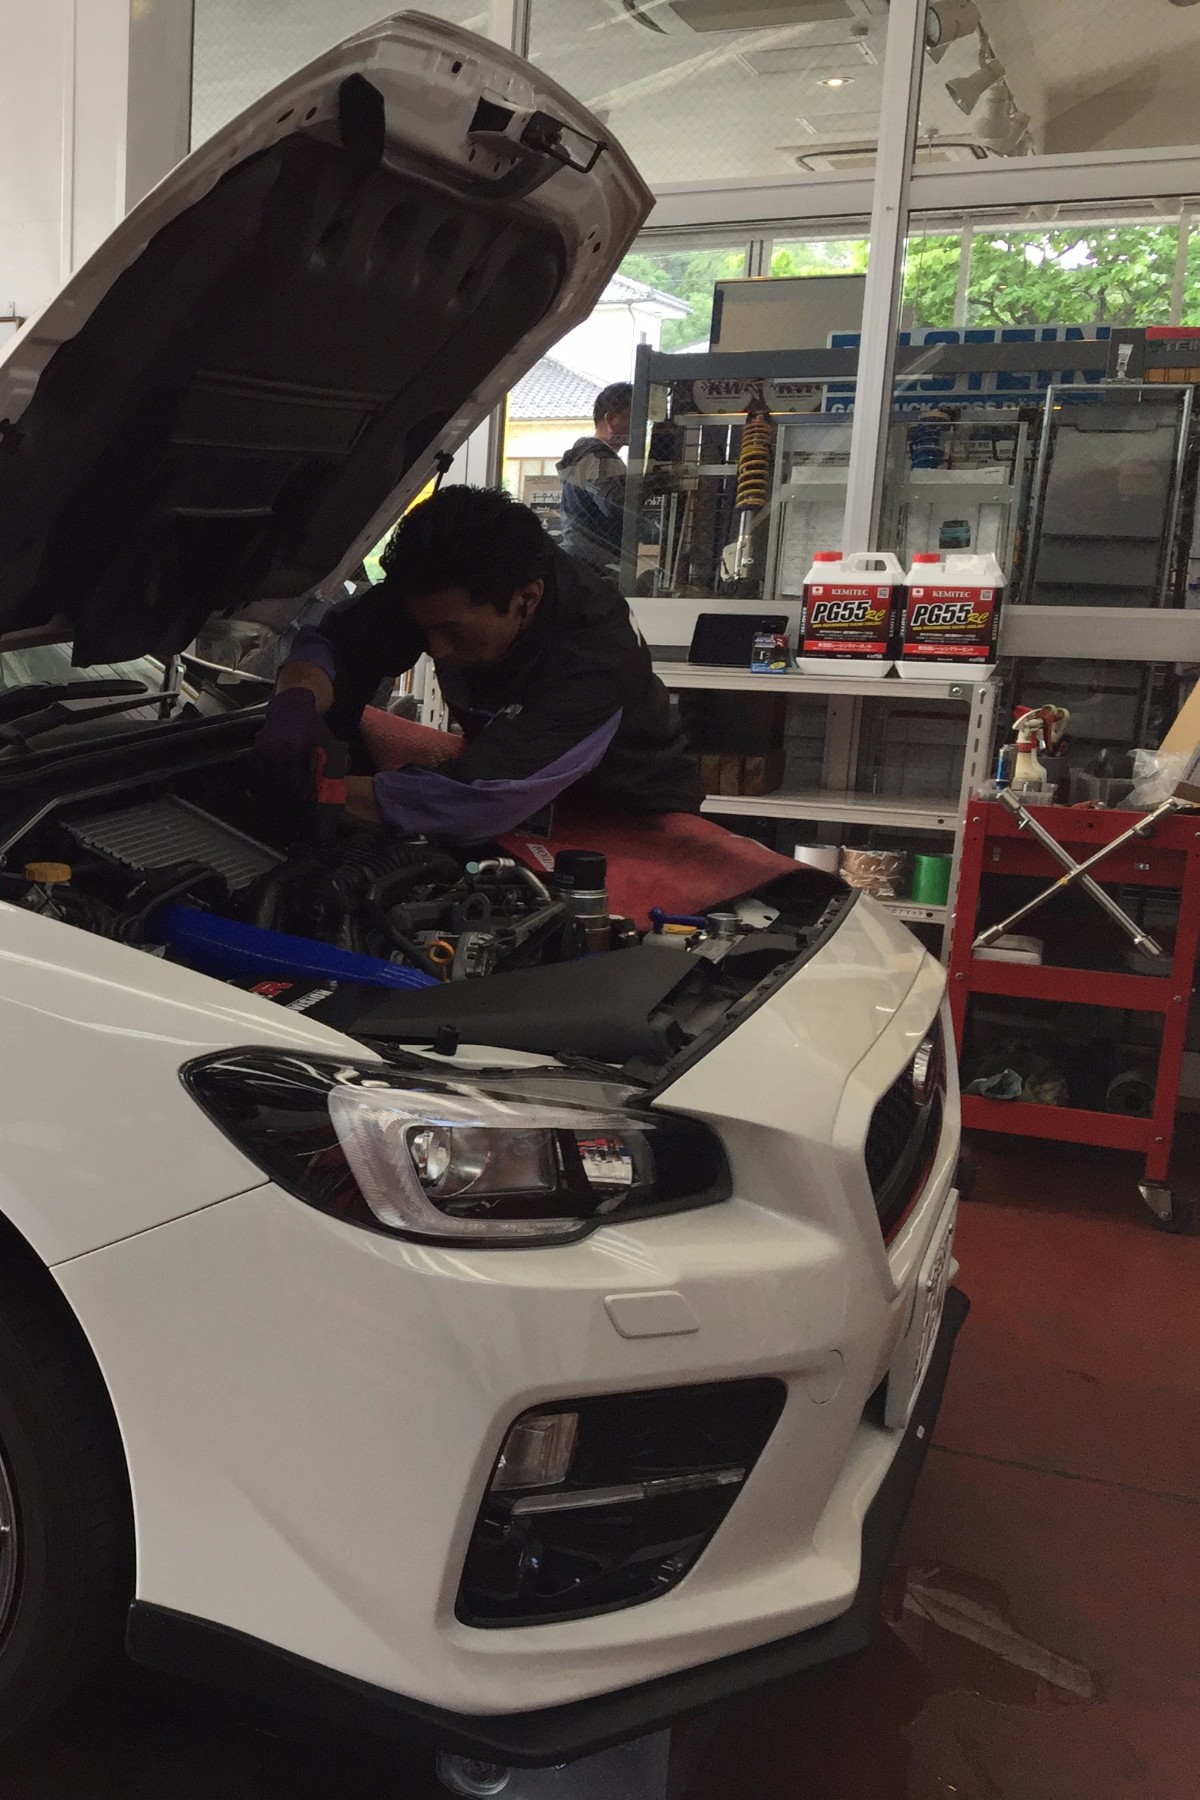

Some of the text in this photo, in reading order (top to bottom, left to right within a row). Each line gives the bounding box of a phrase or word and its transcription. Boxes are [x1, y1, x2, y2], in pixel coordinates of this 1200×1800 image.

[832, 588, 869, 596] KEMITEC
[932, 590, 972, 598] KEMITEC
[810, 599, 872, 624] PG55
[910, 601, 975, 626] PG55
